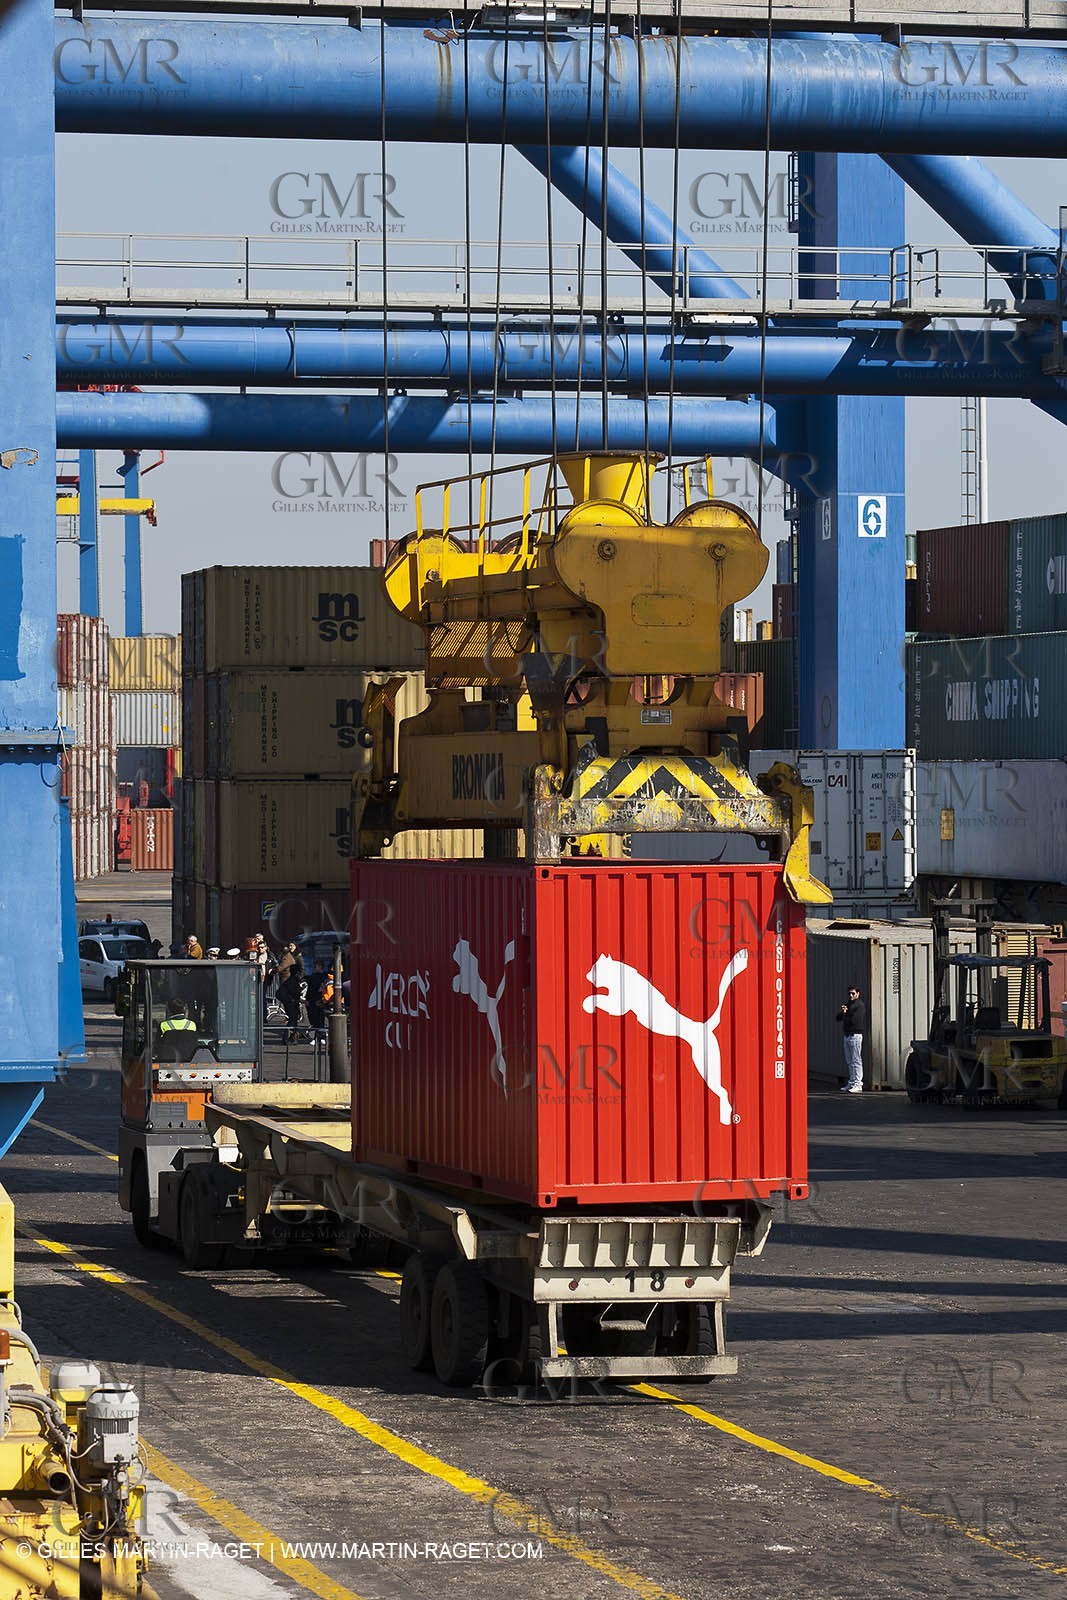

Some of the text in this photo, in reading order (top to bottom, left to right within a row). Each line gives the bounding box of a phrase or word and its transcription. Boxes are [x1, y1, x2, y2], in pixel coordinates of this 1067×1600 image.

[862, 498, 882, 536] 6
[945, 678, 1039, 720] CHINA SHIPPING
[452, 753, 505, 800] BROMMA
[827, 774, 848, 788] CAI
[776, 919, 784, 1078] CASU 012046 8
